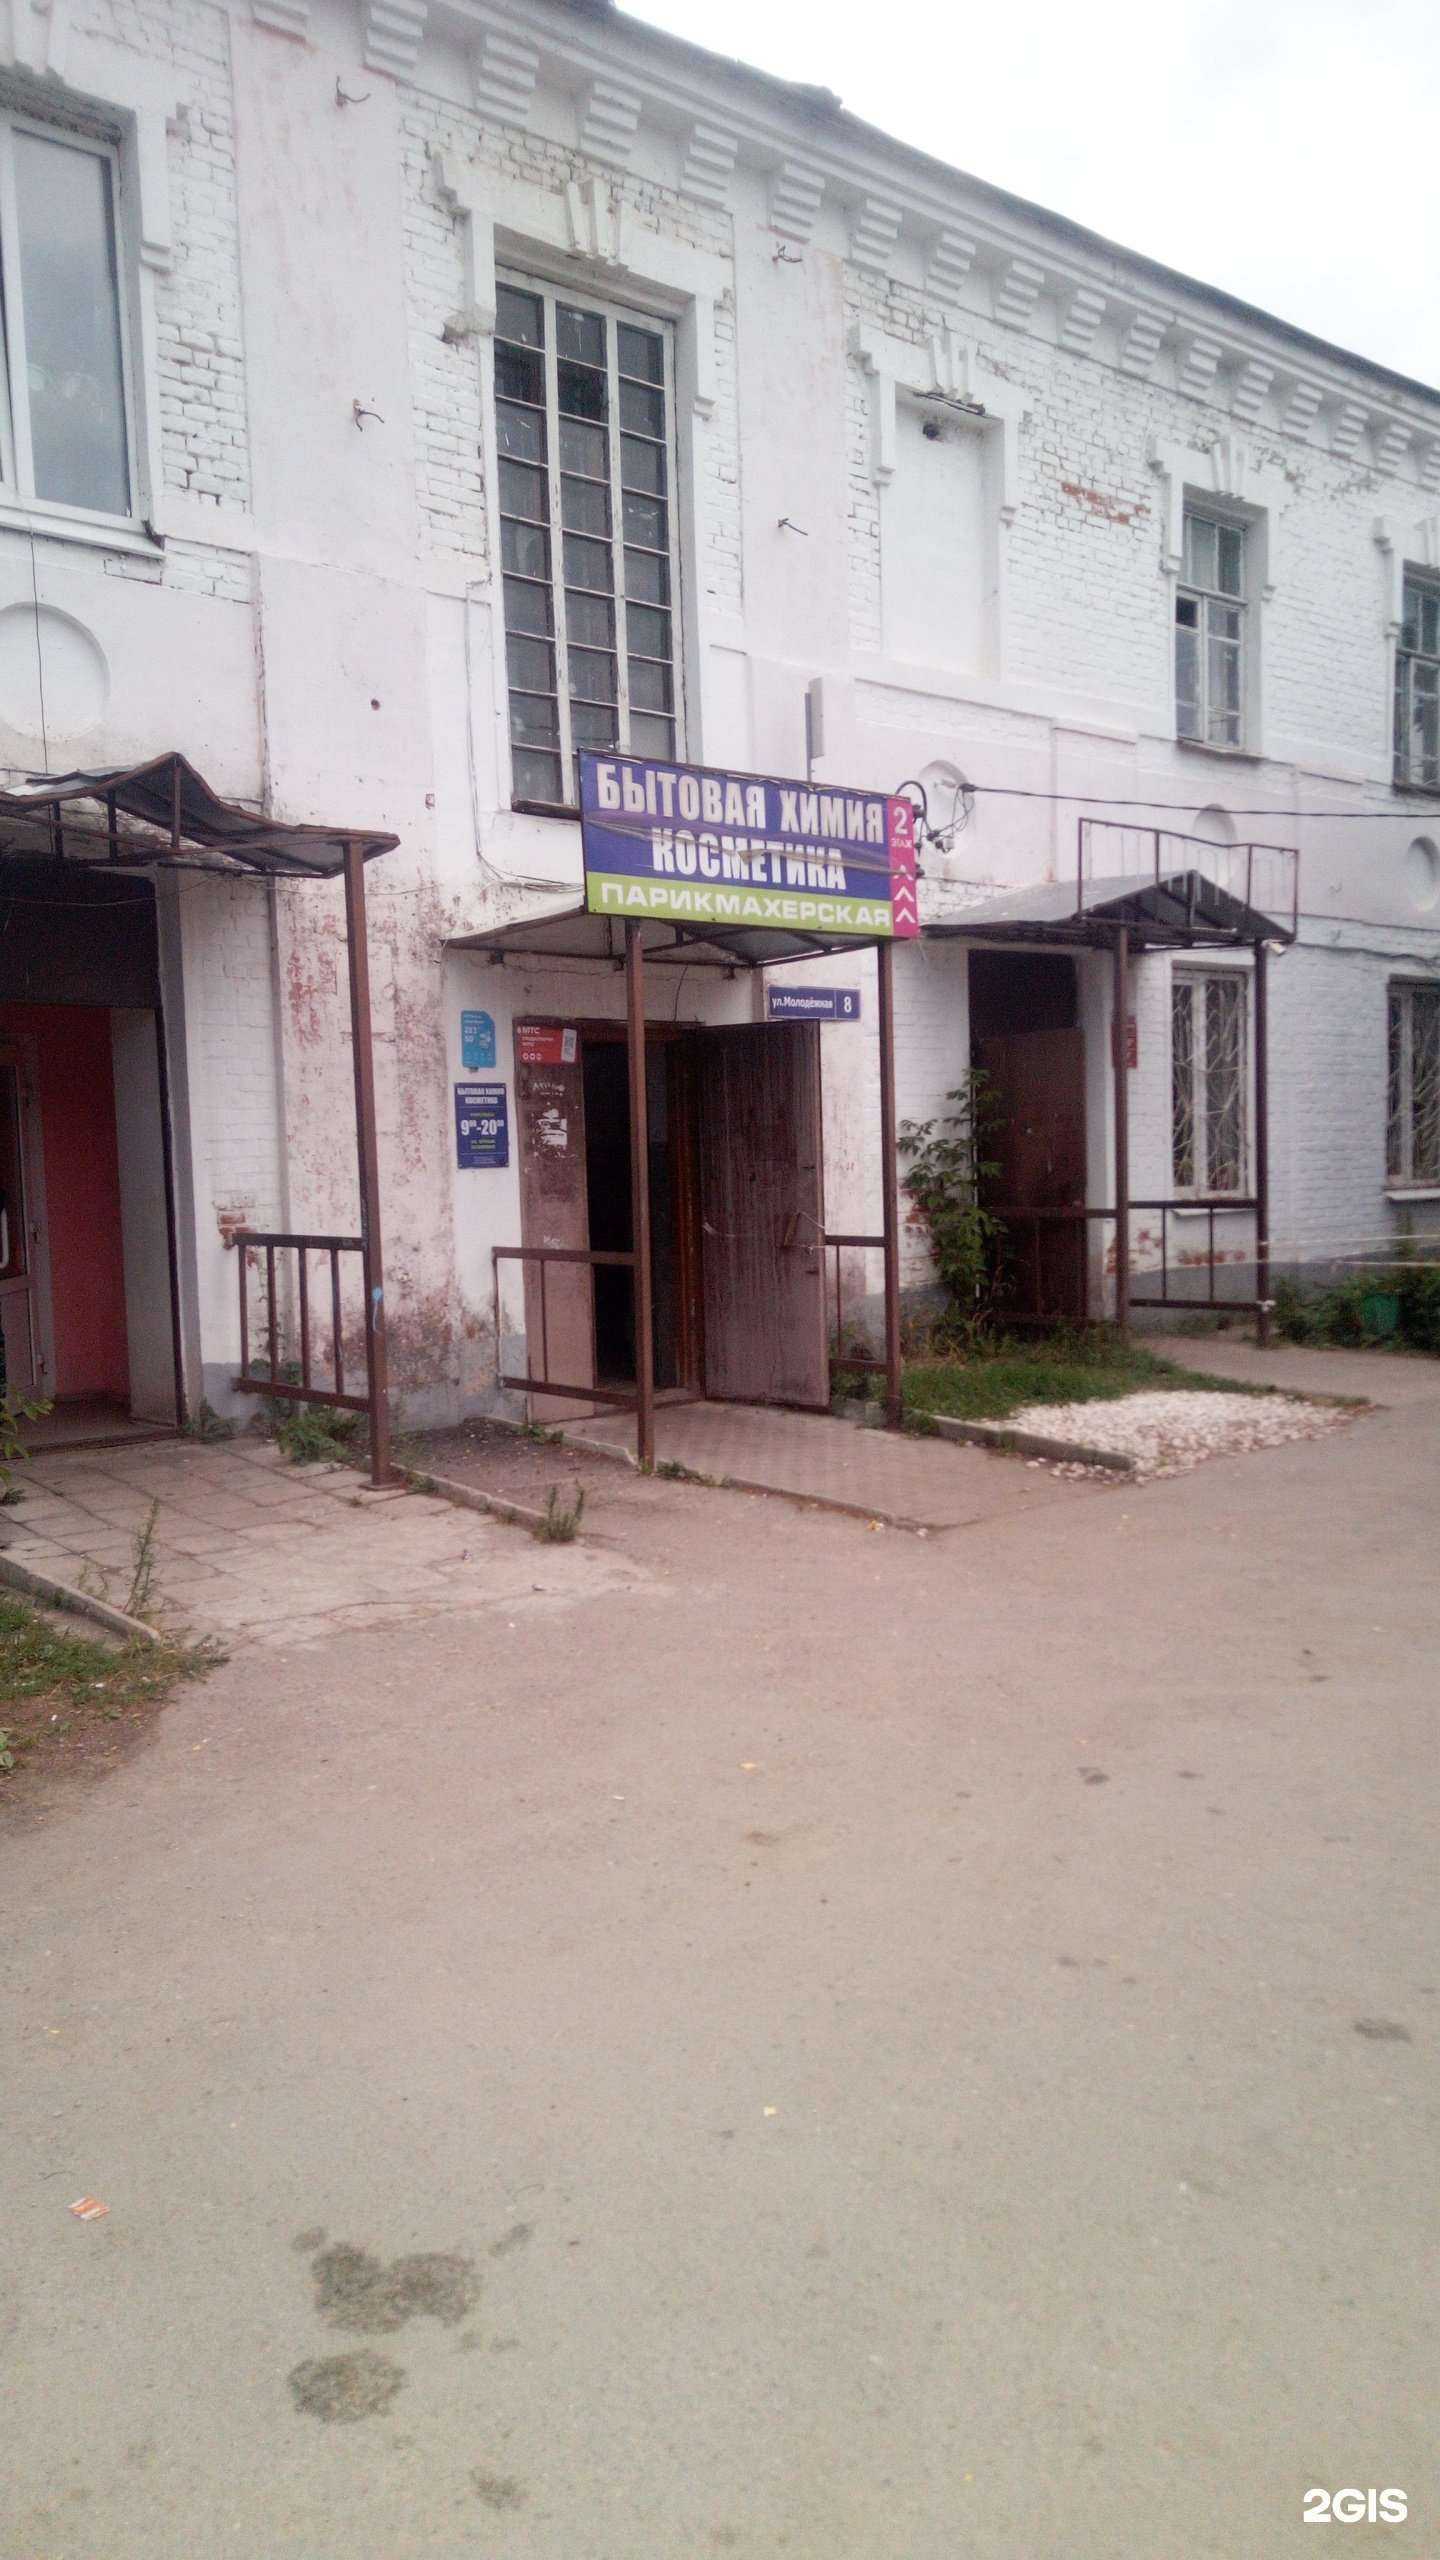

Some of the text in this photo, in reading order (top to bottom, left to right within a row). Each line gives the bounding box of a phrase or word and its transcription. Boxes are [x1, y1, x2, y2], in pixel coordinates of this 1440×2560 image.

[596, 763, 884, 844] БЫТОВАЯ ХИМИЯ
[893, 806, 908, 835] 2
[652, 827, 847, 890] КОСМЕТИКА
[601, 882, 891, 927] ПАРИКМАХЕРСКАЯ
[843, 996, 852, 1013] 8
